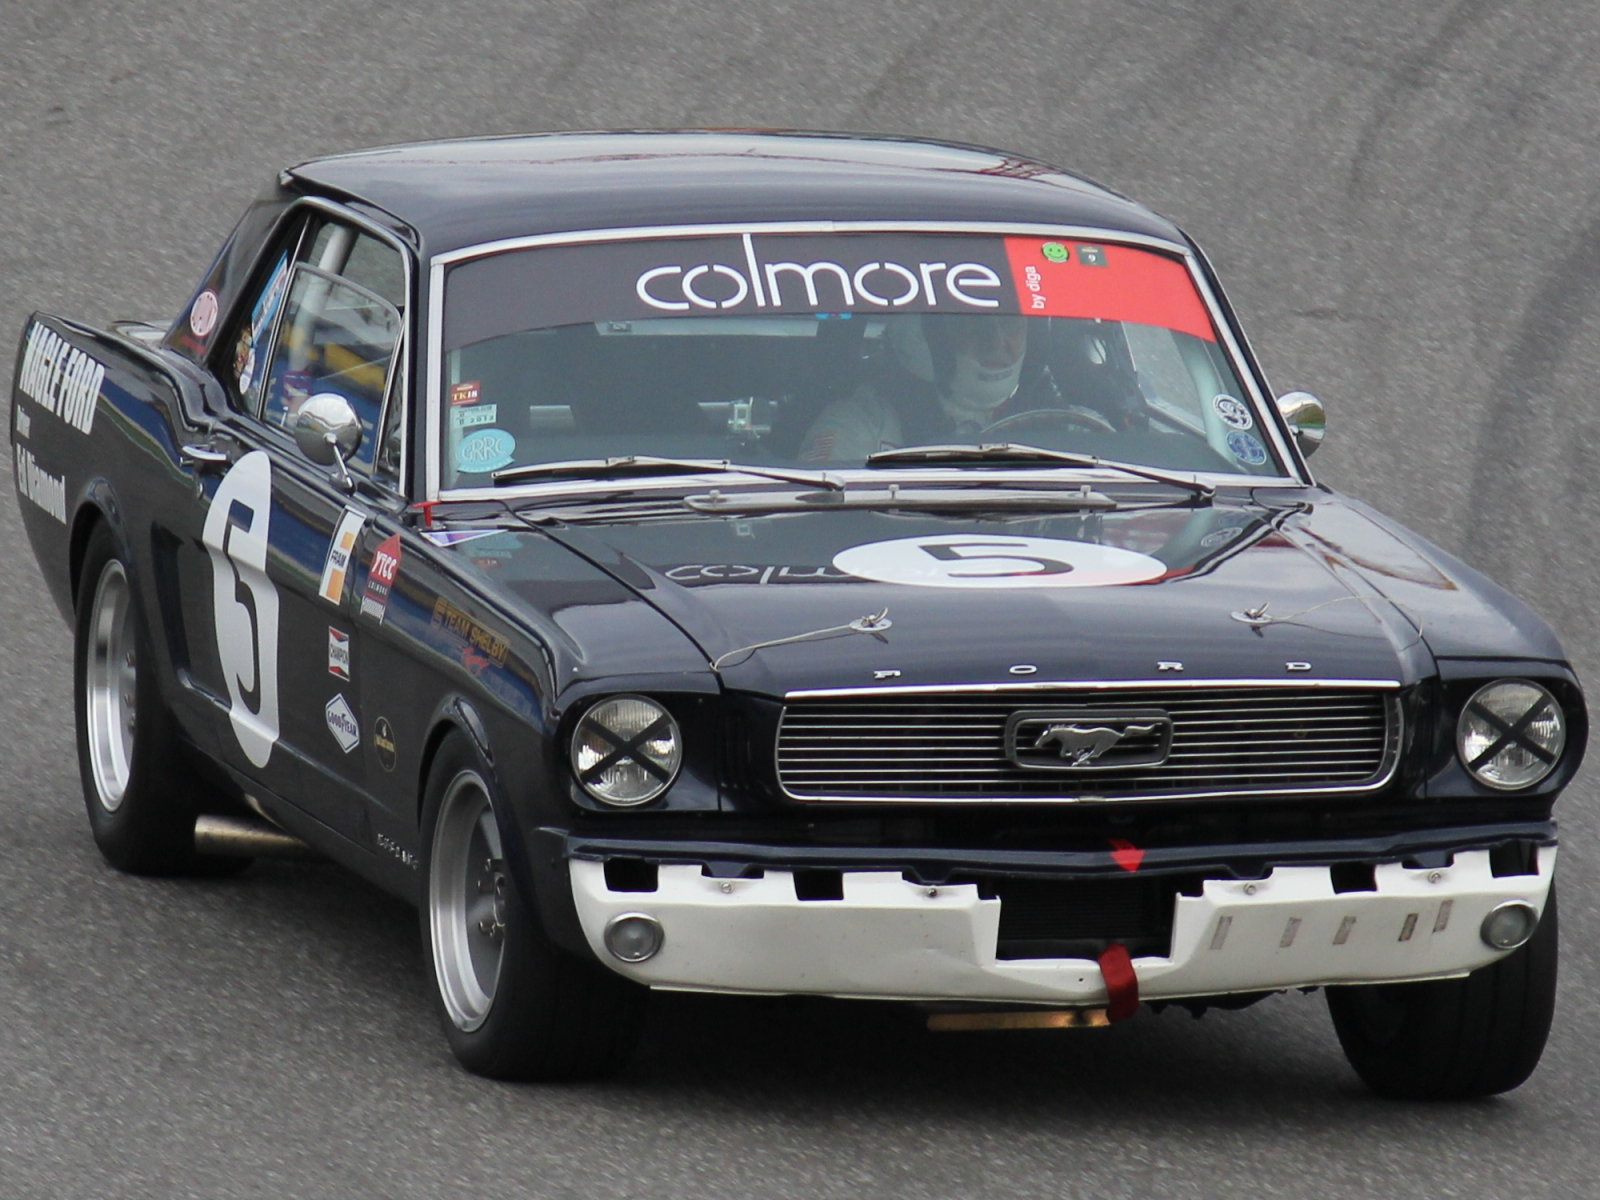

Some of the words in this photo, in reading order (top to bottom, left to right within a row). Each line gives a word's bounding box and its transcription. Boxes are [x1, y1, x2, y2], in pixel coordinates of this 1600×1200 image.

[637, 233, 1001, 311] colmore
[1024, 266, 1042, 292] diga
[1031, 293, 1047, 309] by
[56, 347, 105, 435] FORD
[461, 436, 508, 462] GRRC
[371, 551, 398, 580] YTCC
[919, 543, 1075, 579] 5
[222, 498, 262, 715] 5
[443, 611, 471, 638] TEAM
[470, 627, 507, 661] SHELBY
[327, 711, 357, 737] GOODYEAR
